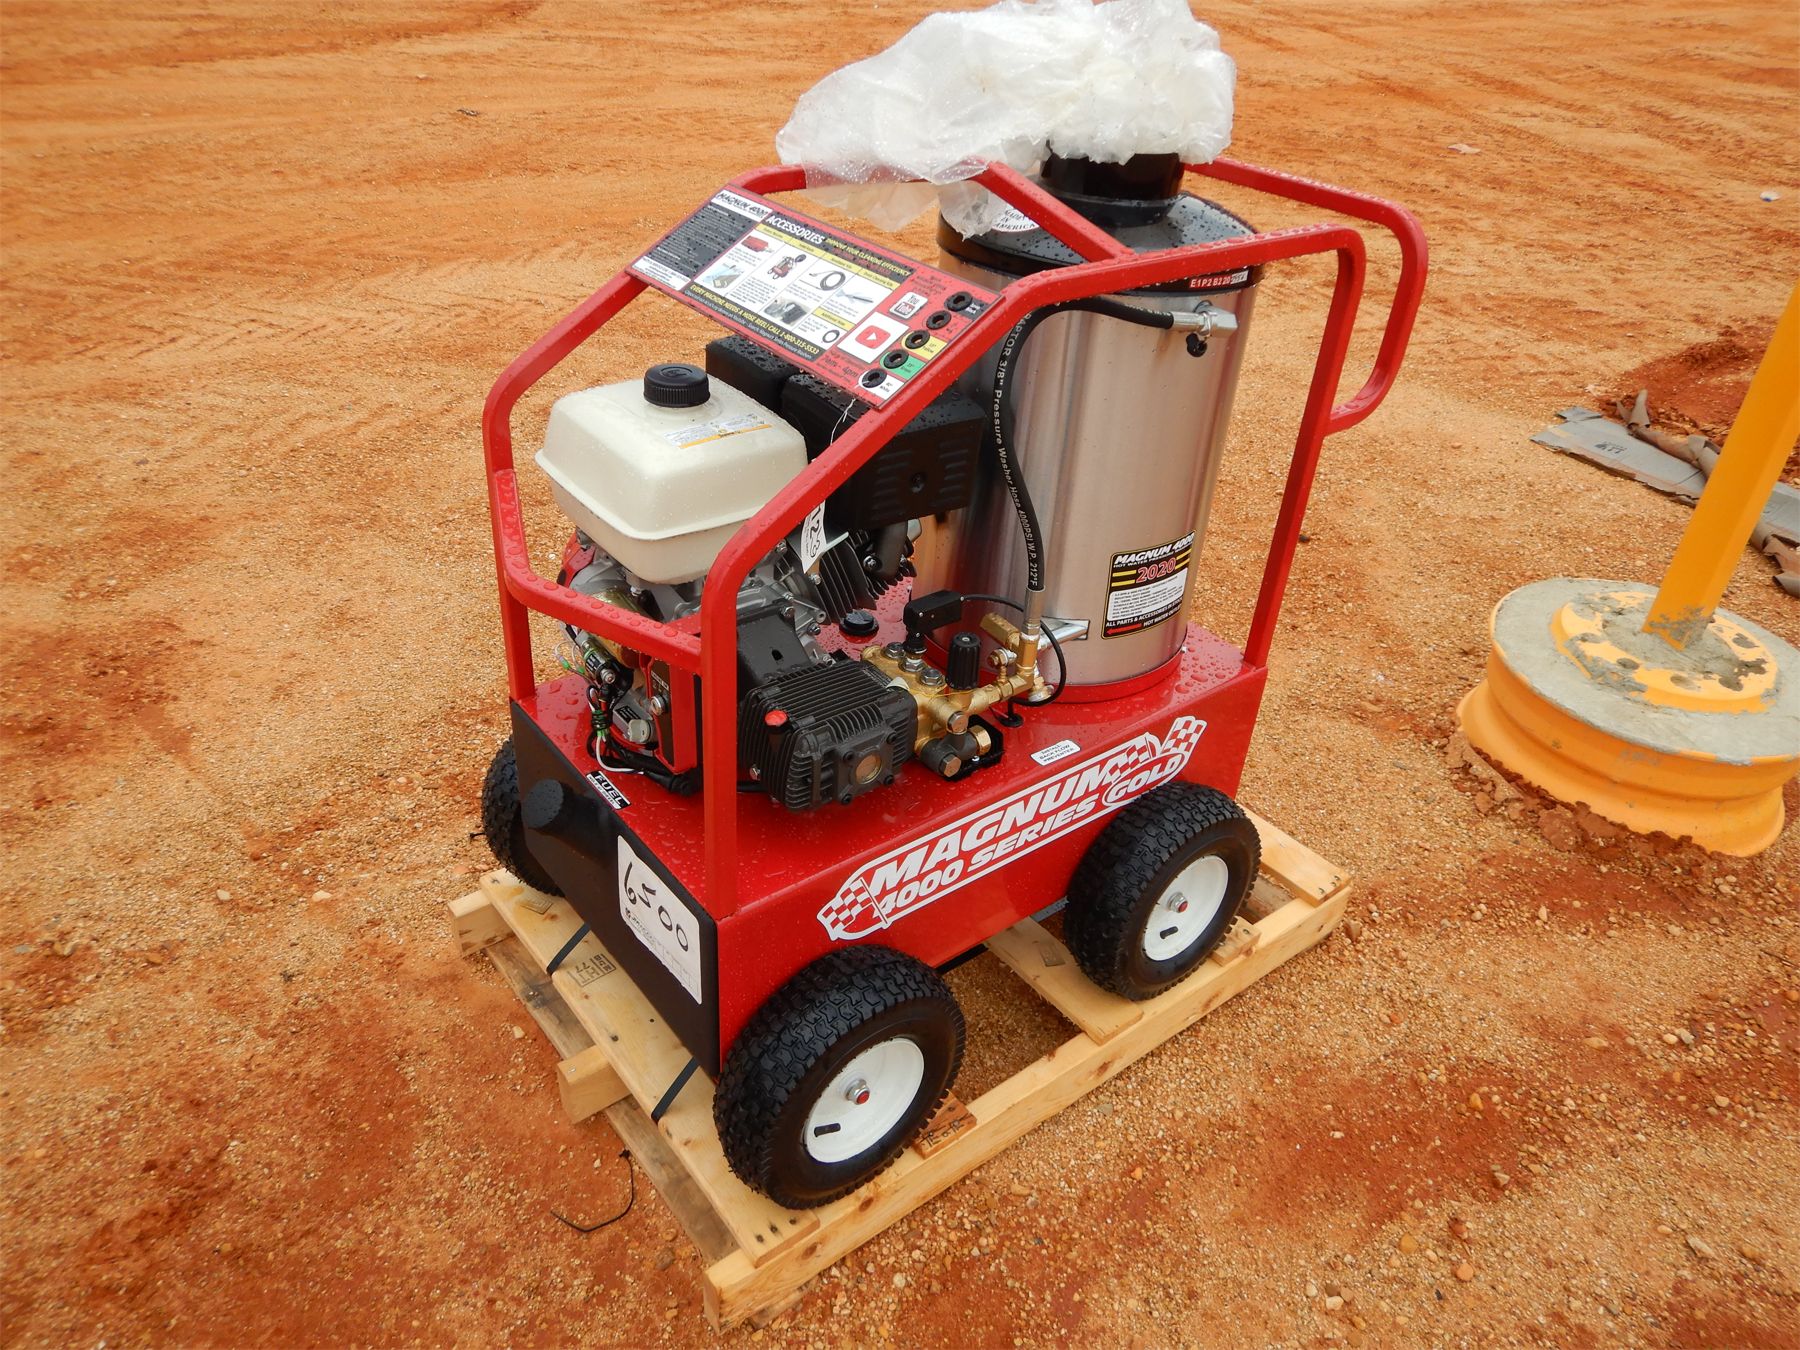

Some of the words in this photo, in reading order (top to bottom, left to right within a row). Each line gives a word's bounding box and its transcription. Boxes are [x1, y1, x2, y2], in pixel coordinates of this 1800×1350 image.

[764, 214, 826, 245] ACCESSORIES
[994, 222, 1036, 230] AMERICA
[689, 284, 708, 297] EVERY
[740, 311, 757, 323] HOSE
[766, 325, 783, 337] CALL
[993, 389, 1004, 445] Pressure
[998, 447, 1013, 485] Washer
[1115, 543, 1173, 565] MAGNUM
[1127, 559, 1148, 567] WATER
[1136, 557, 1177, 583] 2020
[1106, 620, 1116, 628] ALL
[1116, 617, 1134, 626] PARTS
[595, 774, 623, 805] FUEL
[1109, 755, 1182, 801] GOLD
[869, 758, 1122, 895] MAGNUM
[873, 860, 964, 919] 4000
[967, 793, 1100, 873] SERIES
